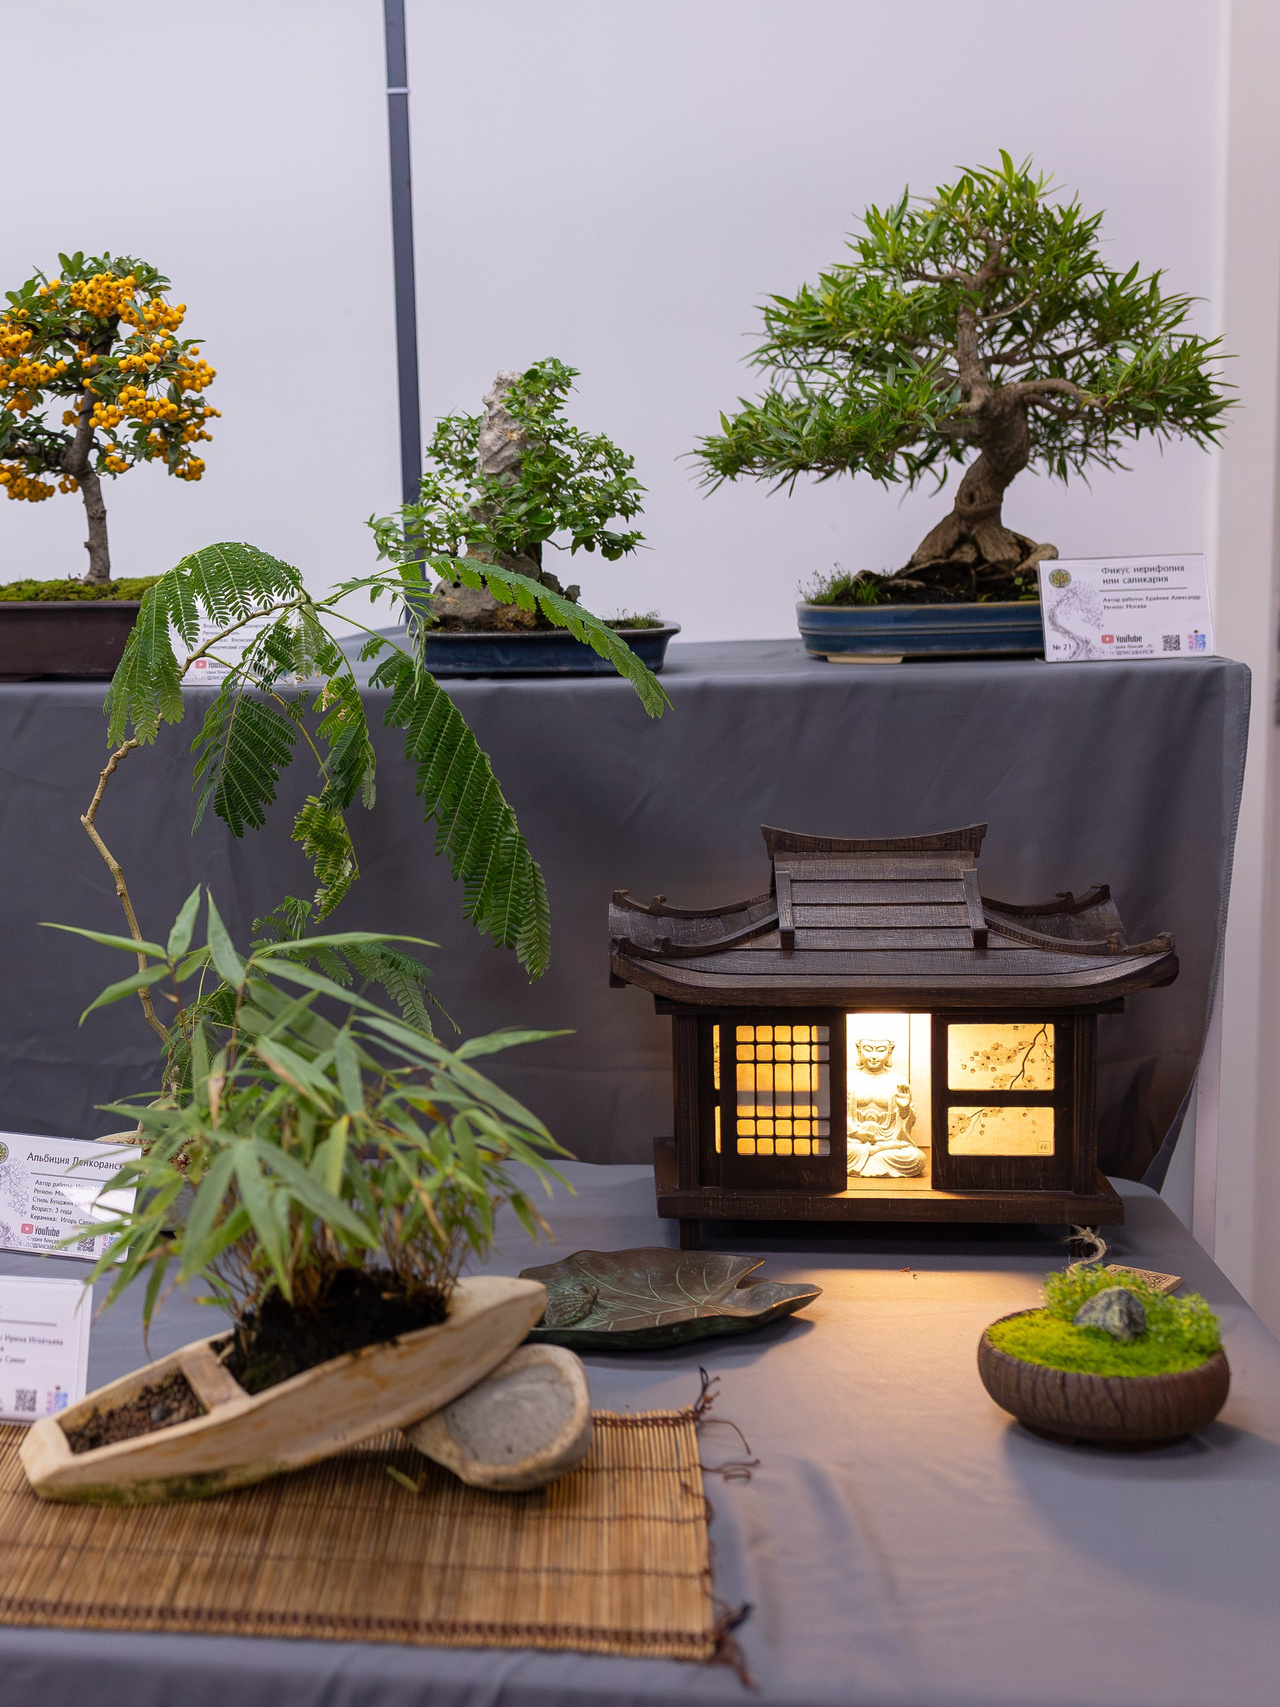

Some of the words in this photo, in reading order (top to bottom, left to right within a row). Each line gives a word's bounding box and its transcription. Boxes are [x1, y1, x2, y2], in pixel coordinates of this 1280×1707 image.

[1102, 566, 1130, 575] Фикус
[1116, 634, 1142, 643] YouTube
[27, 1152, 70, 1165] Альбиция
[72, 1156, 125, 1170] Ленкоранск
[30, 1214, 57, 1222] Керамика:
[35, 1225, 60, 1237] YouTube
